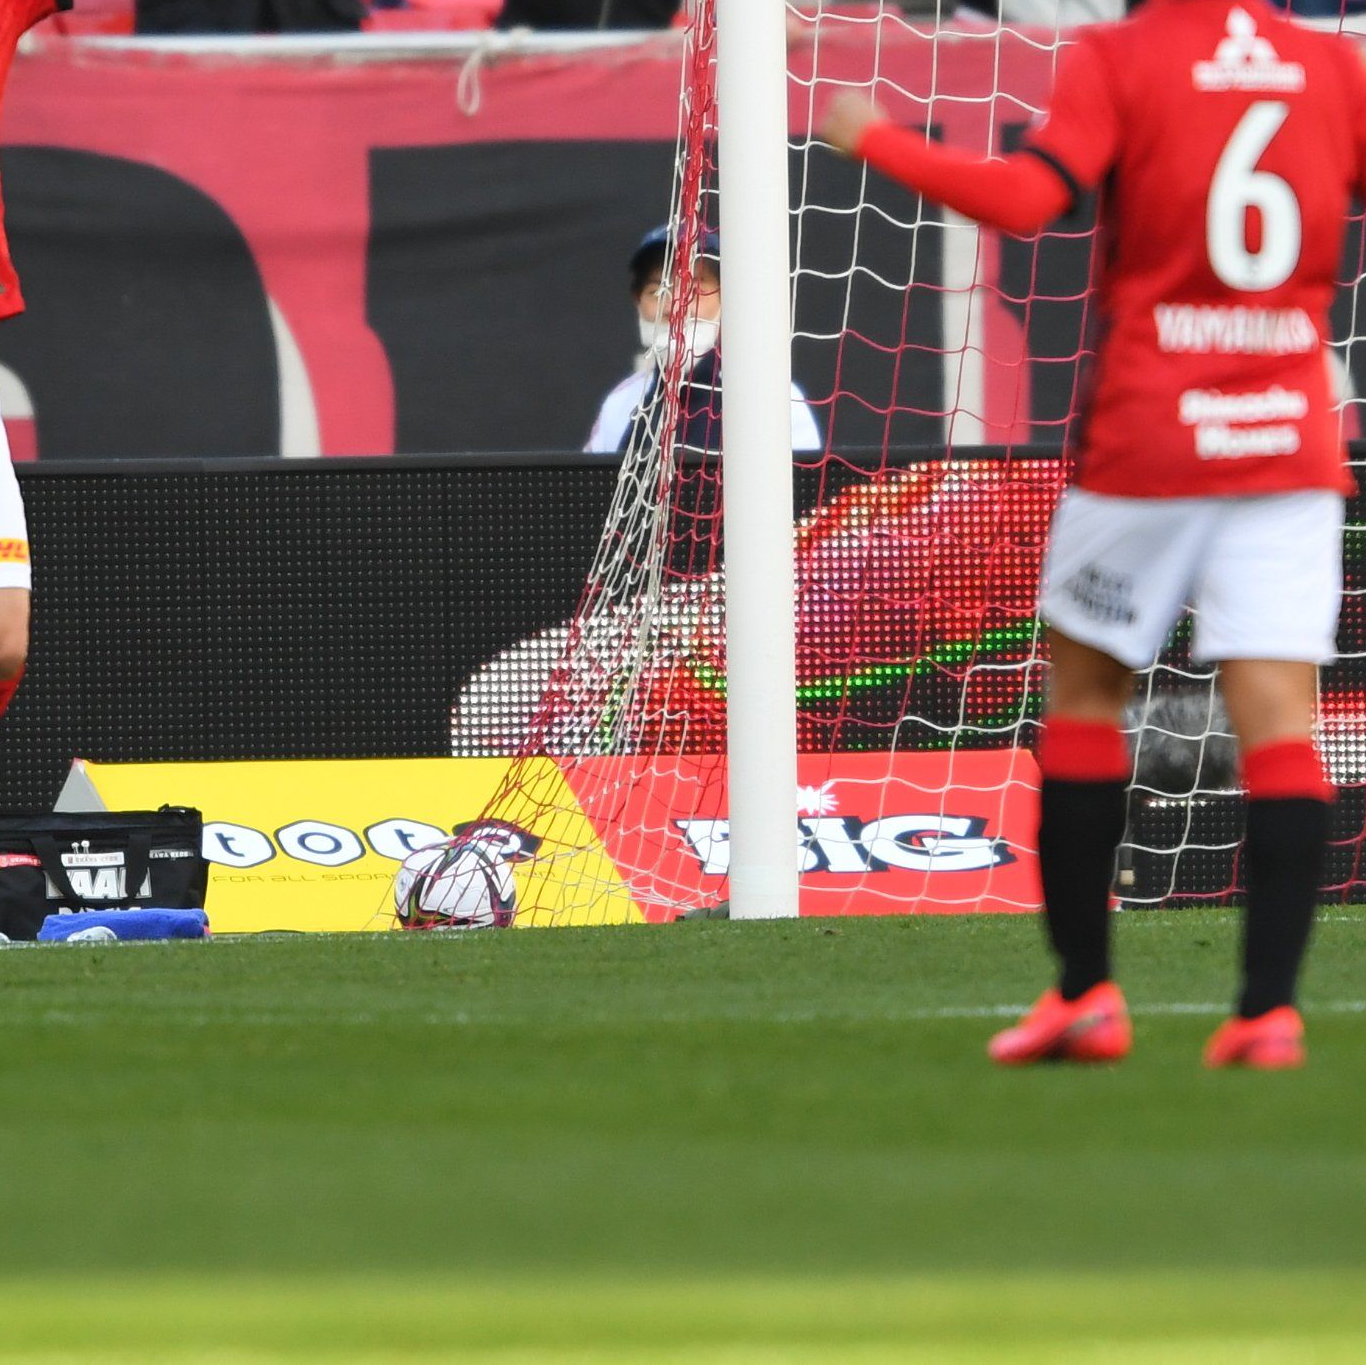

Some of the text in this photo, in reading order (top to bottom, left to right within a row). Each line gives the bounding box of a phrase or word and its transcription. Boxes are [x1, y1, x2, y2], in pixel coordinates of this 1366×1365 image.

[1206, 100, 1302, 293] 6
[675, 815, 1009, 874] BIG
[321, 872, 395, 882] SPOR
